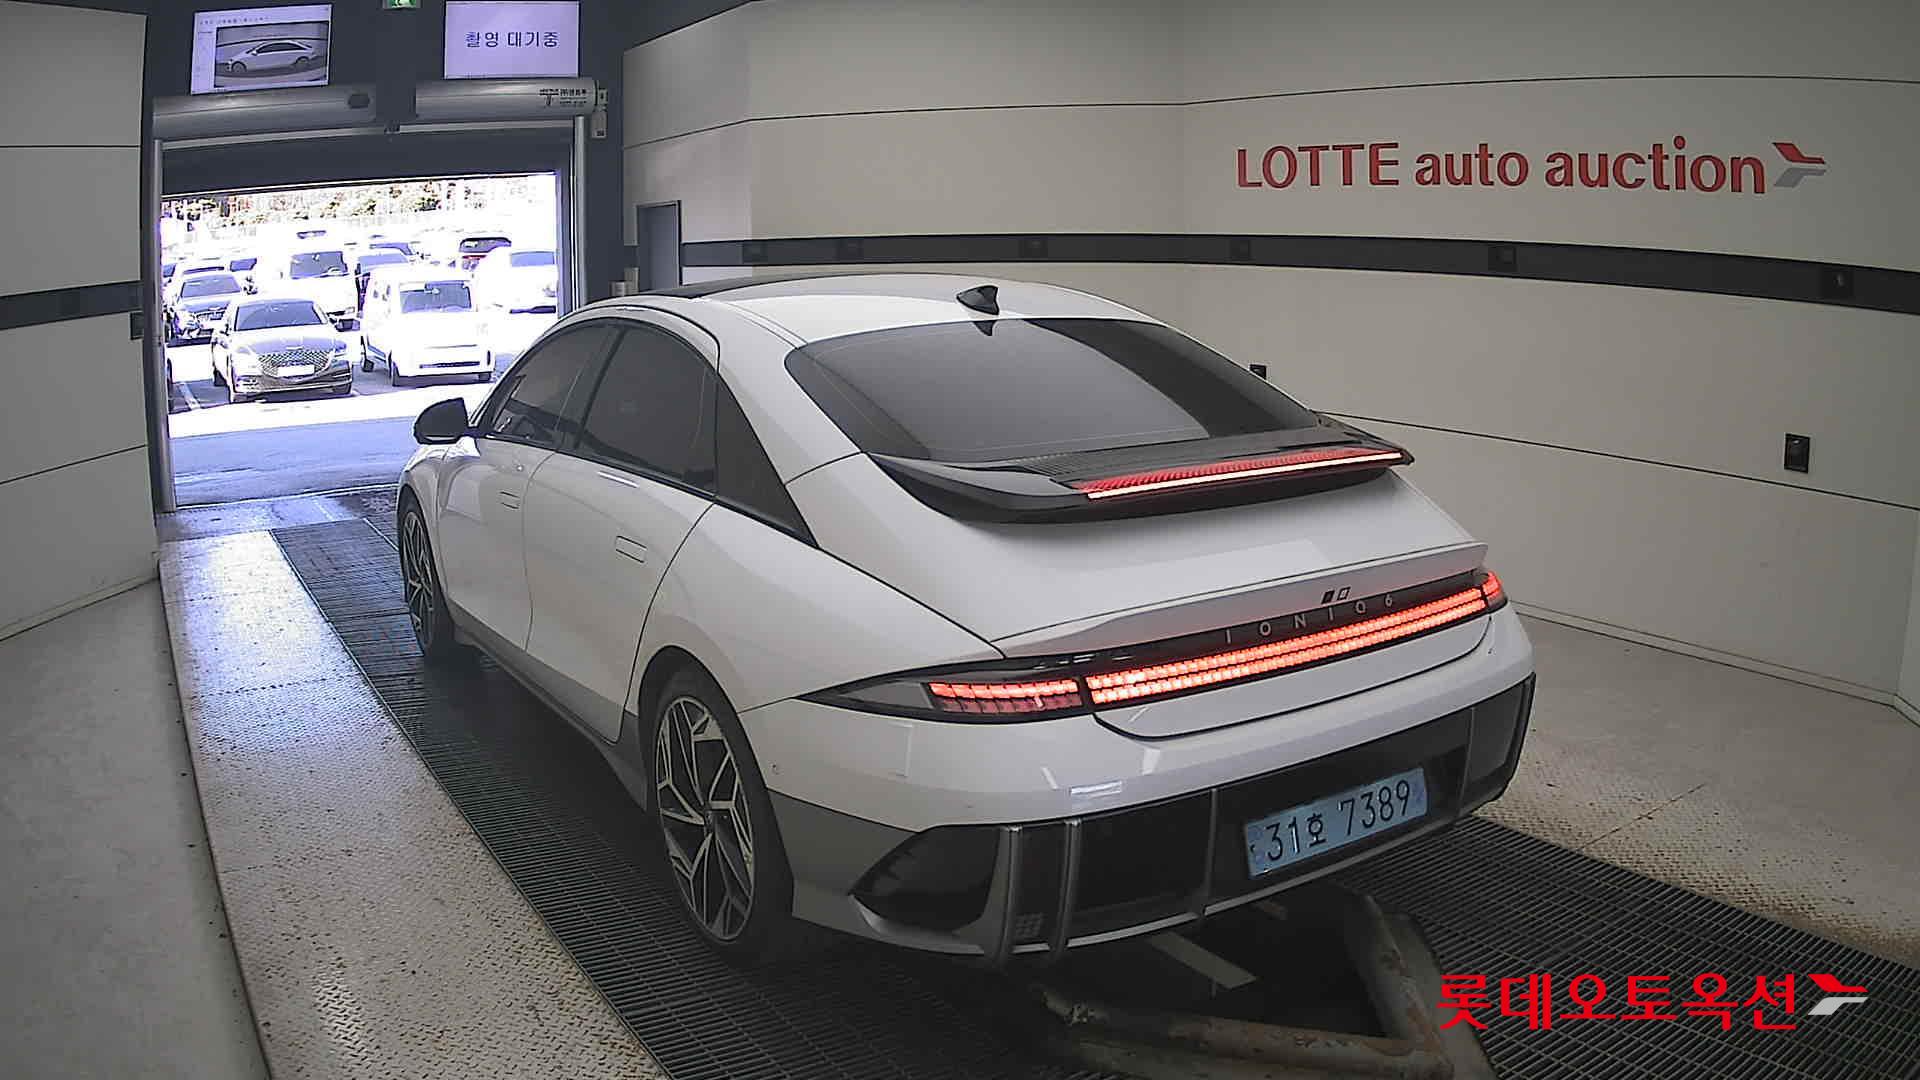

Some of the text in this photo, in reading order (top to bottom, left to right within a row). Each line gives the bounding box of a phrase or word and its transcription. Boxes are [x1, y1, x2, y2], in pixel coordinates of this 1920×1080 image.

[466, 31, 559, 48] 촬영 대기중
[1236, 136, 1766, 194] LOTTE auto auction
[1265, 780, 1410, 861] 31호 7389
